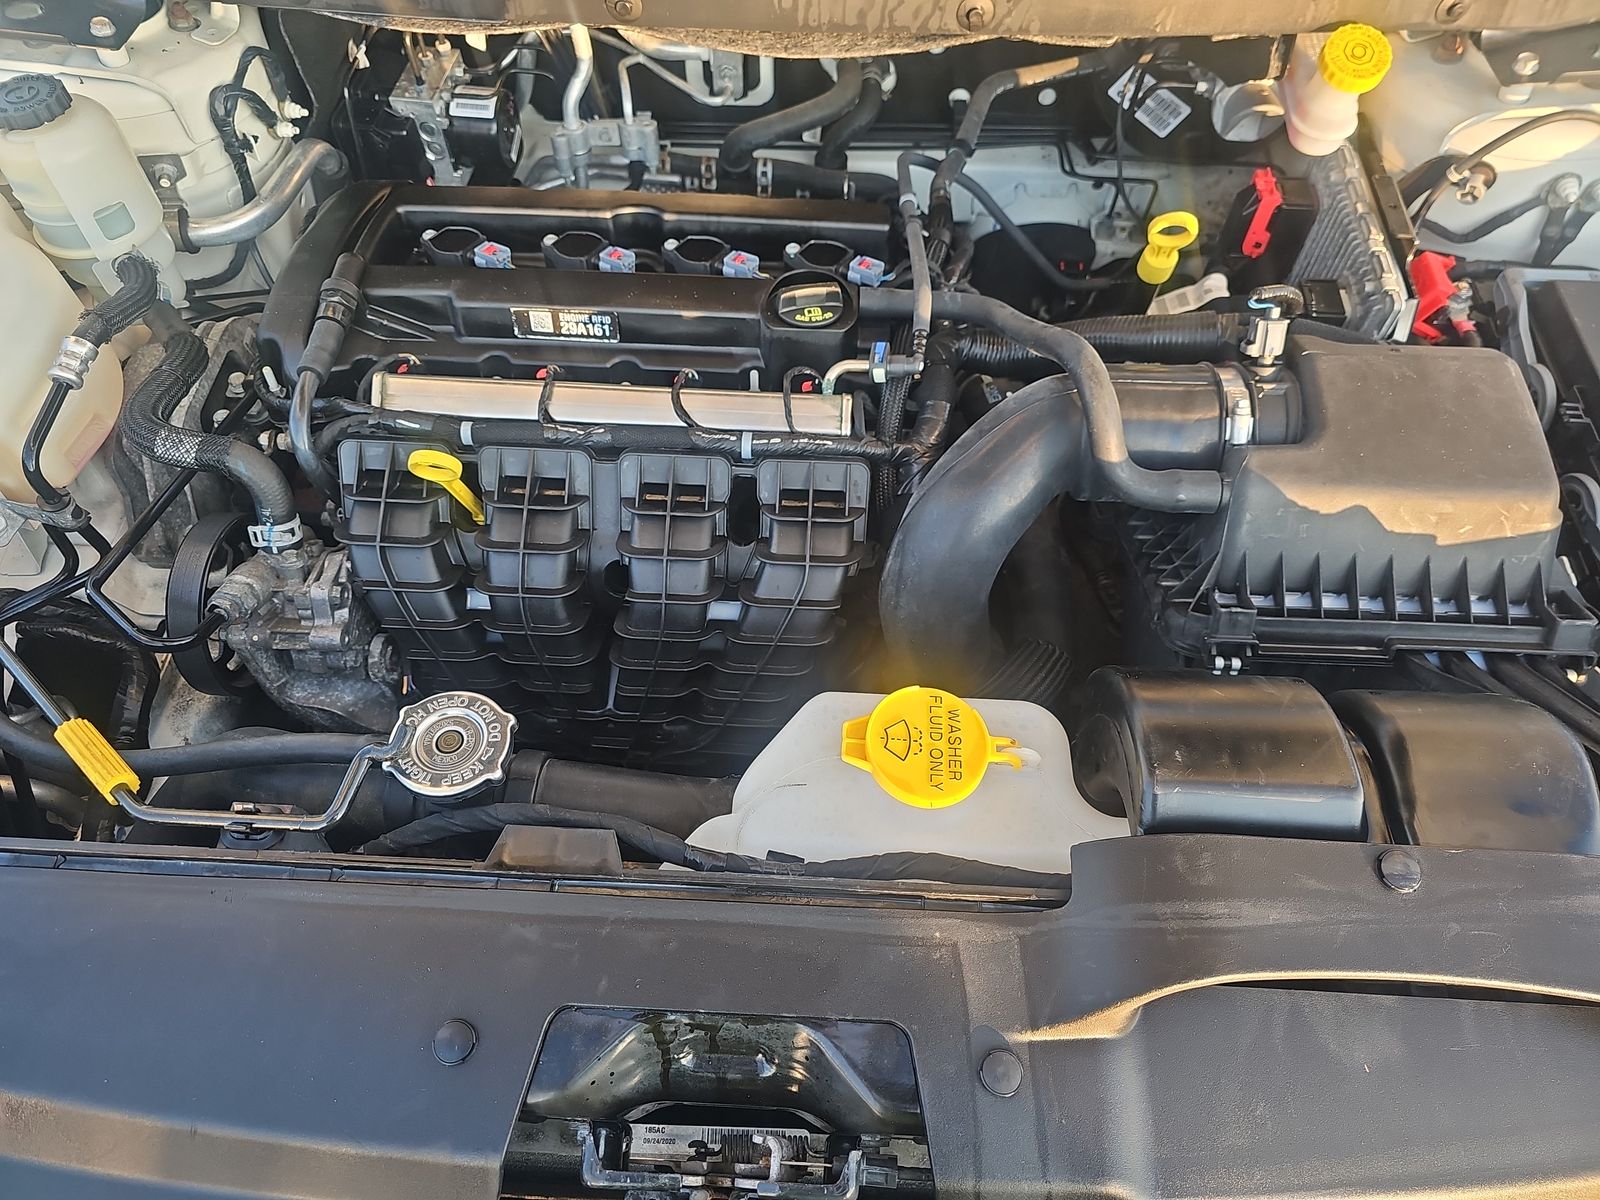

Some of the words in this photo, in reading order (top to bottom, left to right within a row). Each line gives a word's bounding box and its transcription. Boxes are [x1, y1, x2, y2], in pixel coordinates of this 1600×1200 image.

[558, 312, 591, 323] ENGINE
[591, 314, 612, 325] RFID
[559, 321, 610, 337] 29A161
[426, 695, 469, 713] OPEN
[469, 701, 497, 722] NOT
[928, 695, 943, 742] FLUID
[488, 722, 502, 742] DO
[947, 708, 963, 781] WASHER
[431, 754, 458, 763] MEXICO
[398, 757, 433, 786] TIGHT
[441, 761, 484, 786] KEEP
[928, 748, 944, 792] ONLY
[642, 1137, 677, 1146] 09/24/2020
